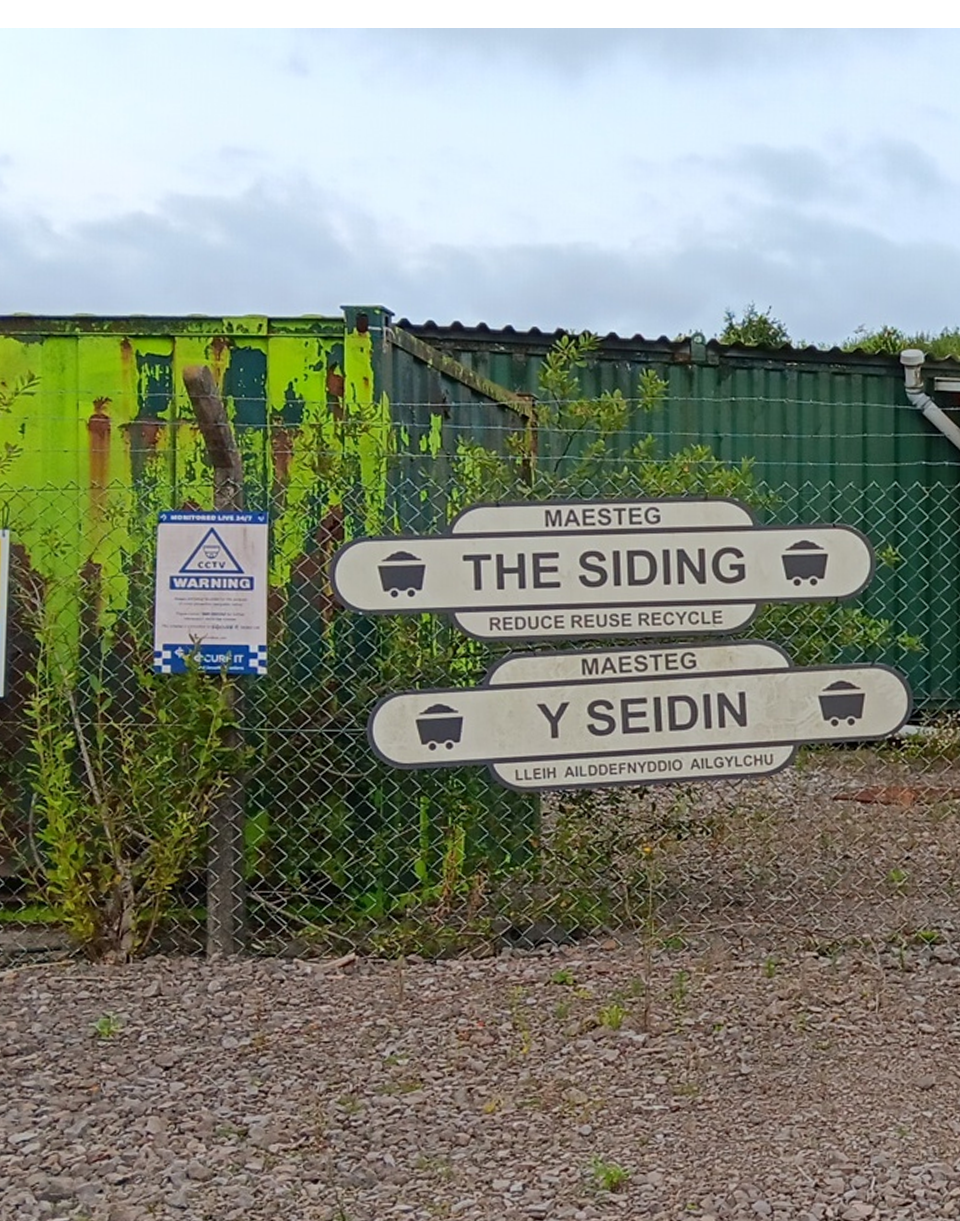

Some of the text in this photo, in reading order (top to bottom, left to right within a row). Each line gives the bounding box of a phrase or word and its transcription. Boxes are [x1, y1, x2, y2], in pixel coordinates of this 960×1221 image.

[544, 506, 662, 528] MAESTEG
[197, 561, 226, 569] CCTV
[463, 547, 746, 591] THE SIDING
[172, 577, 251, 589] WARNING
[489, 610, 723, 631] REDUCE REUSE RECYCLE
[581, 651, 697, 676] MAESTEG
[537, 691, 748, 738] Y SEIDIN
[514, 752, 775, 780] LLEIH AILDDEFNYDDIO AILGYLCHU
